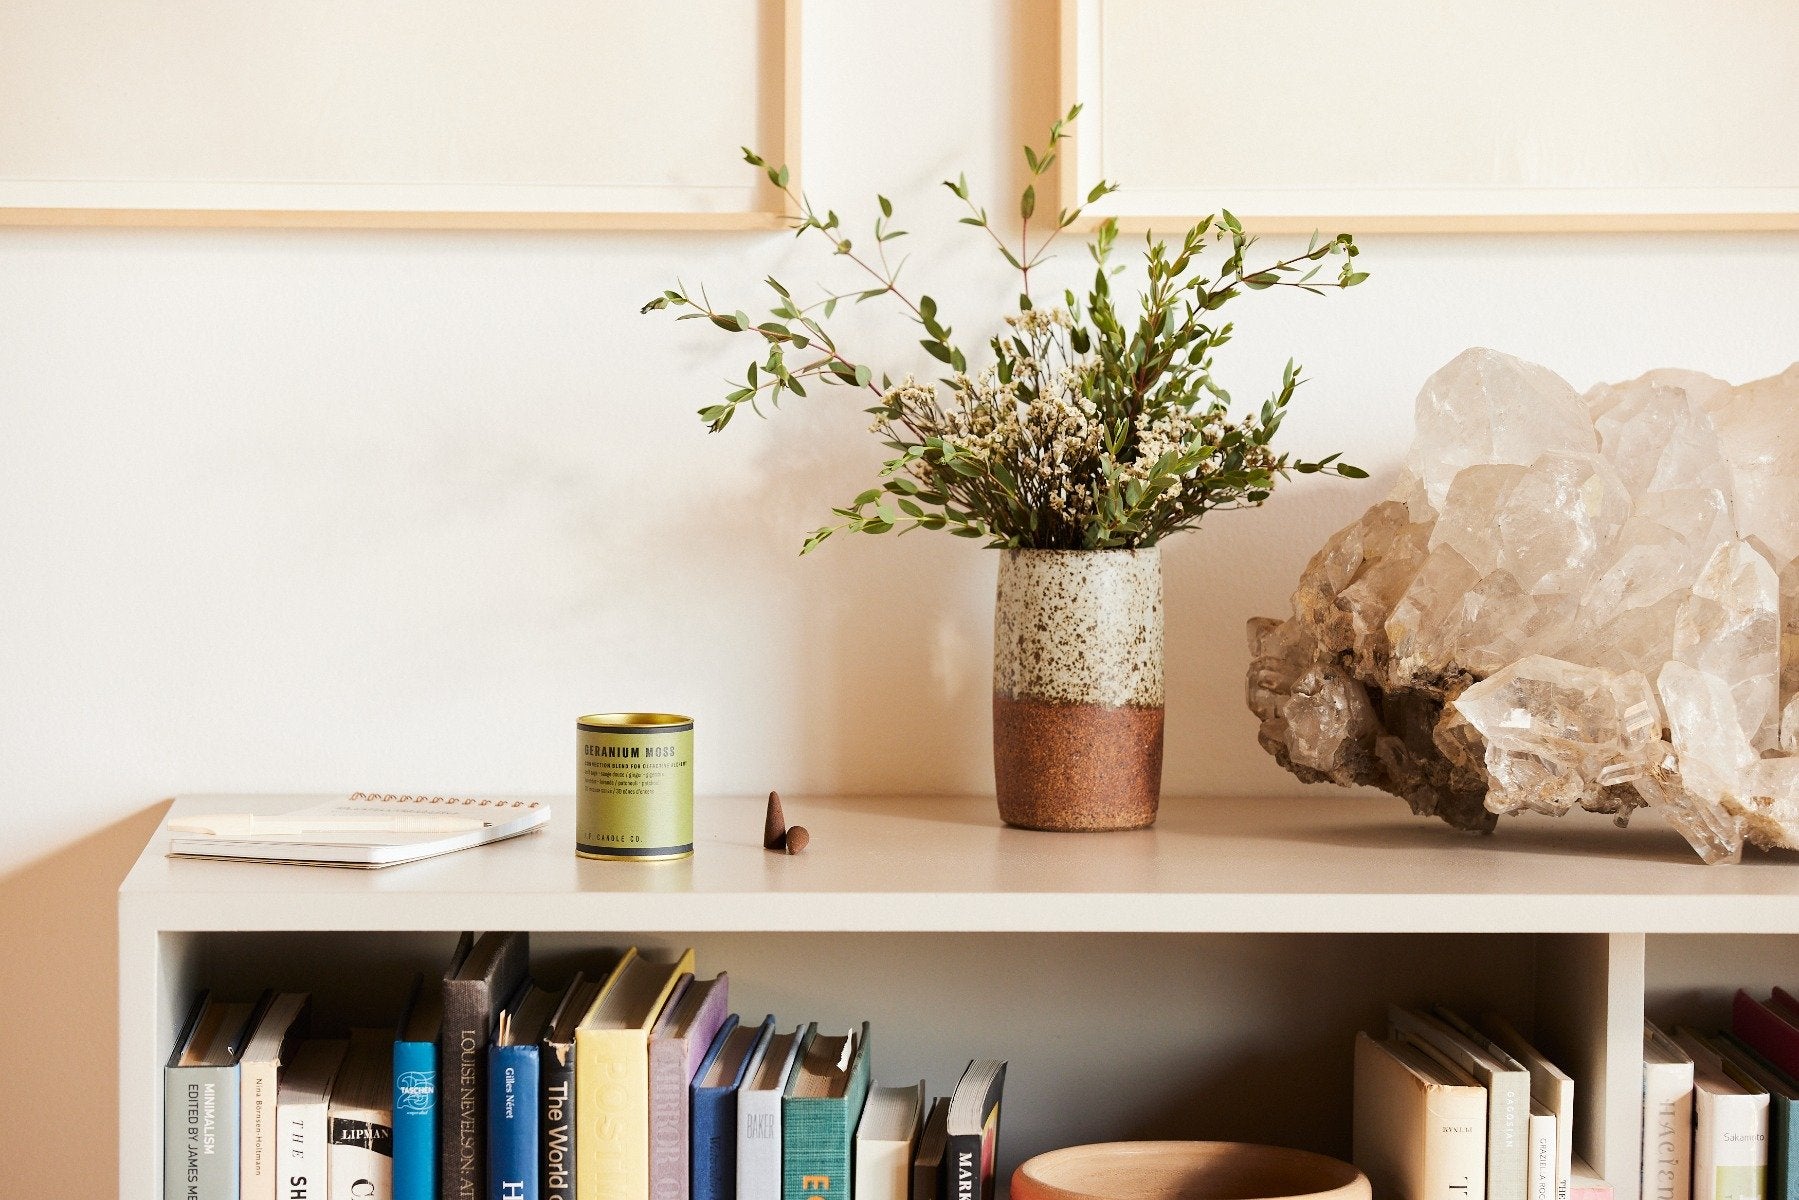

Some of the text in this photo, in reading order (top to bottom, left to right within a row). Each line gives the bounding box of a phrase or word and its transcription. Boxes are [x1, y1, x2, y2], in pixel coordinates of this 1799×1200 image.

[584, 744, 675, 758] GERANIUM MOSS
[460, 1029, 476, 1085] LOUISE
[188, 1084, 199, 1124] EDITED
[255, 1078, 263, 1097] Nina
[400, 1086, 434, 1094] TASCHEN
[505, 1067, 515, 1119] Gilles Néret
[548, 1081, 568, 1122] The
[188, 1127, 199, 1142] BY
[203, 1083, 215, 1155] MINIMALISM
[341, 1129, 389, 1140] LIPMAN
[460, 1087, 475, 1174] NEVELSON:
[746, 1113, 775, 1139] BAKER
[1505, 1091, 1515, 1148] GAGOSIAN
[292, 1120, 304, 1159] THE
[548, 1125, 569, 1189] World
[187, 1144, 199, 1183] JAMES
